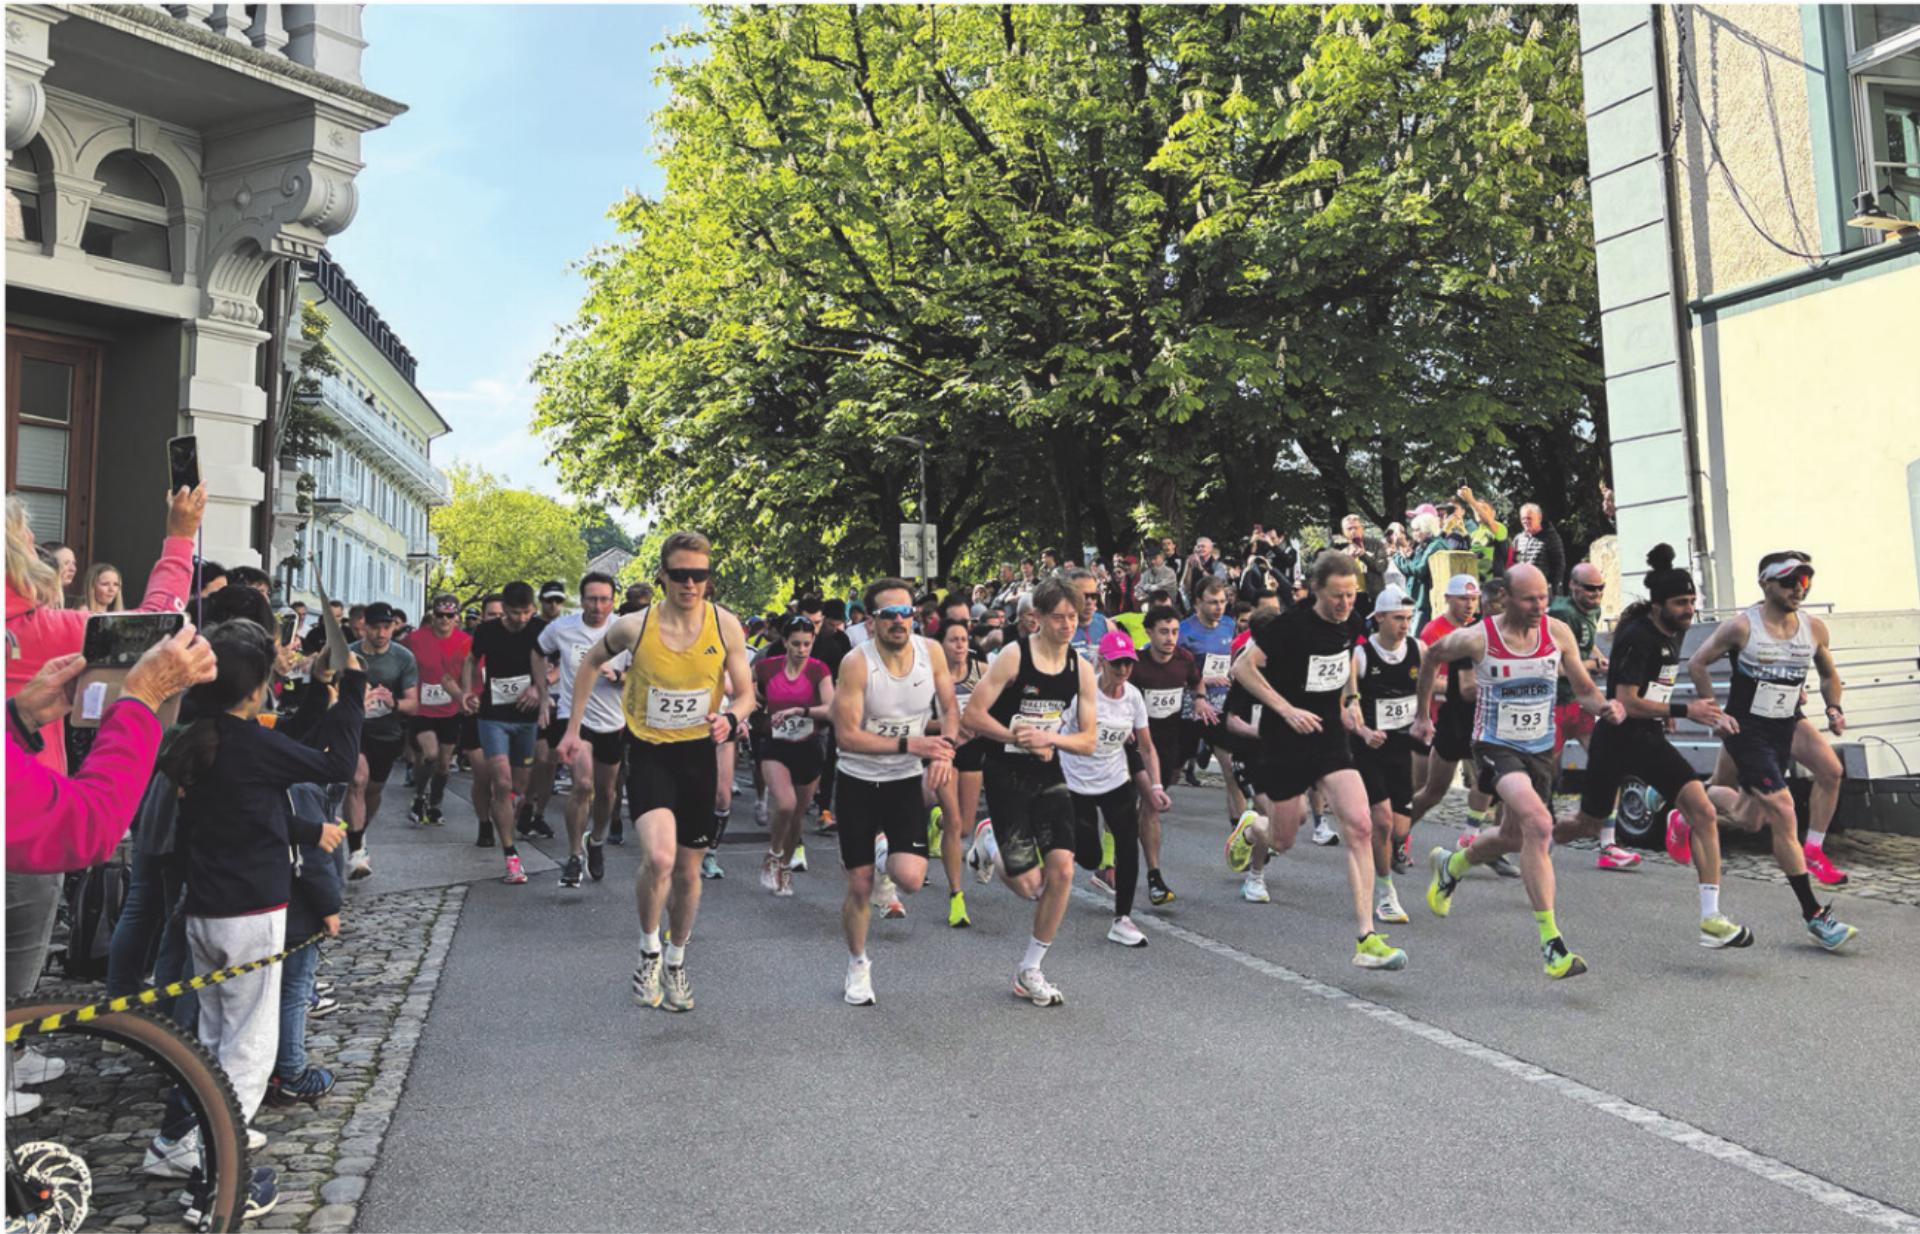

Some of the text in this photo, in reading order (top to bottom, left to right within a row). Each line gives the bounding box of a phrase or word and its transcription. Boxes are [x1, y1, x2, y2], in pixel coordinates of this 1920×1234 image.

[1318, 662, 1344, 677] 224
[502, 683, 519, 693] 26
[660, 698, 697, 713] 252
[1152, 696, 1176, 706] 266
[1776, 694, 1786, 705] 2
[1385, 703, 1410, 717] 281
[1511, 713, 1542, 727] 193
[877, 724, 911, 737] 253
